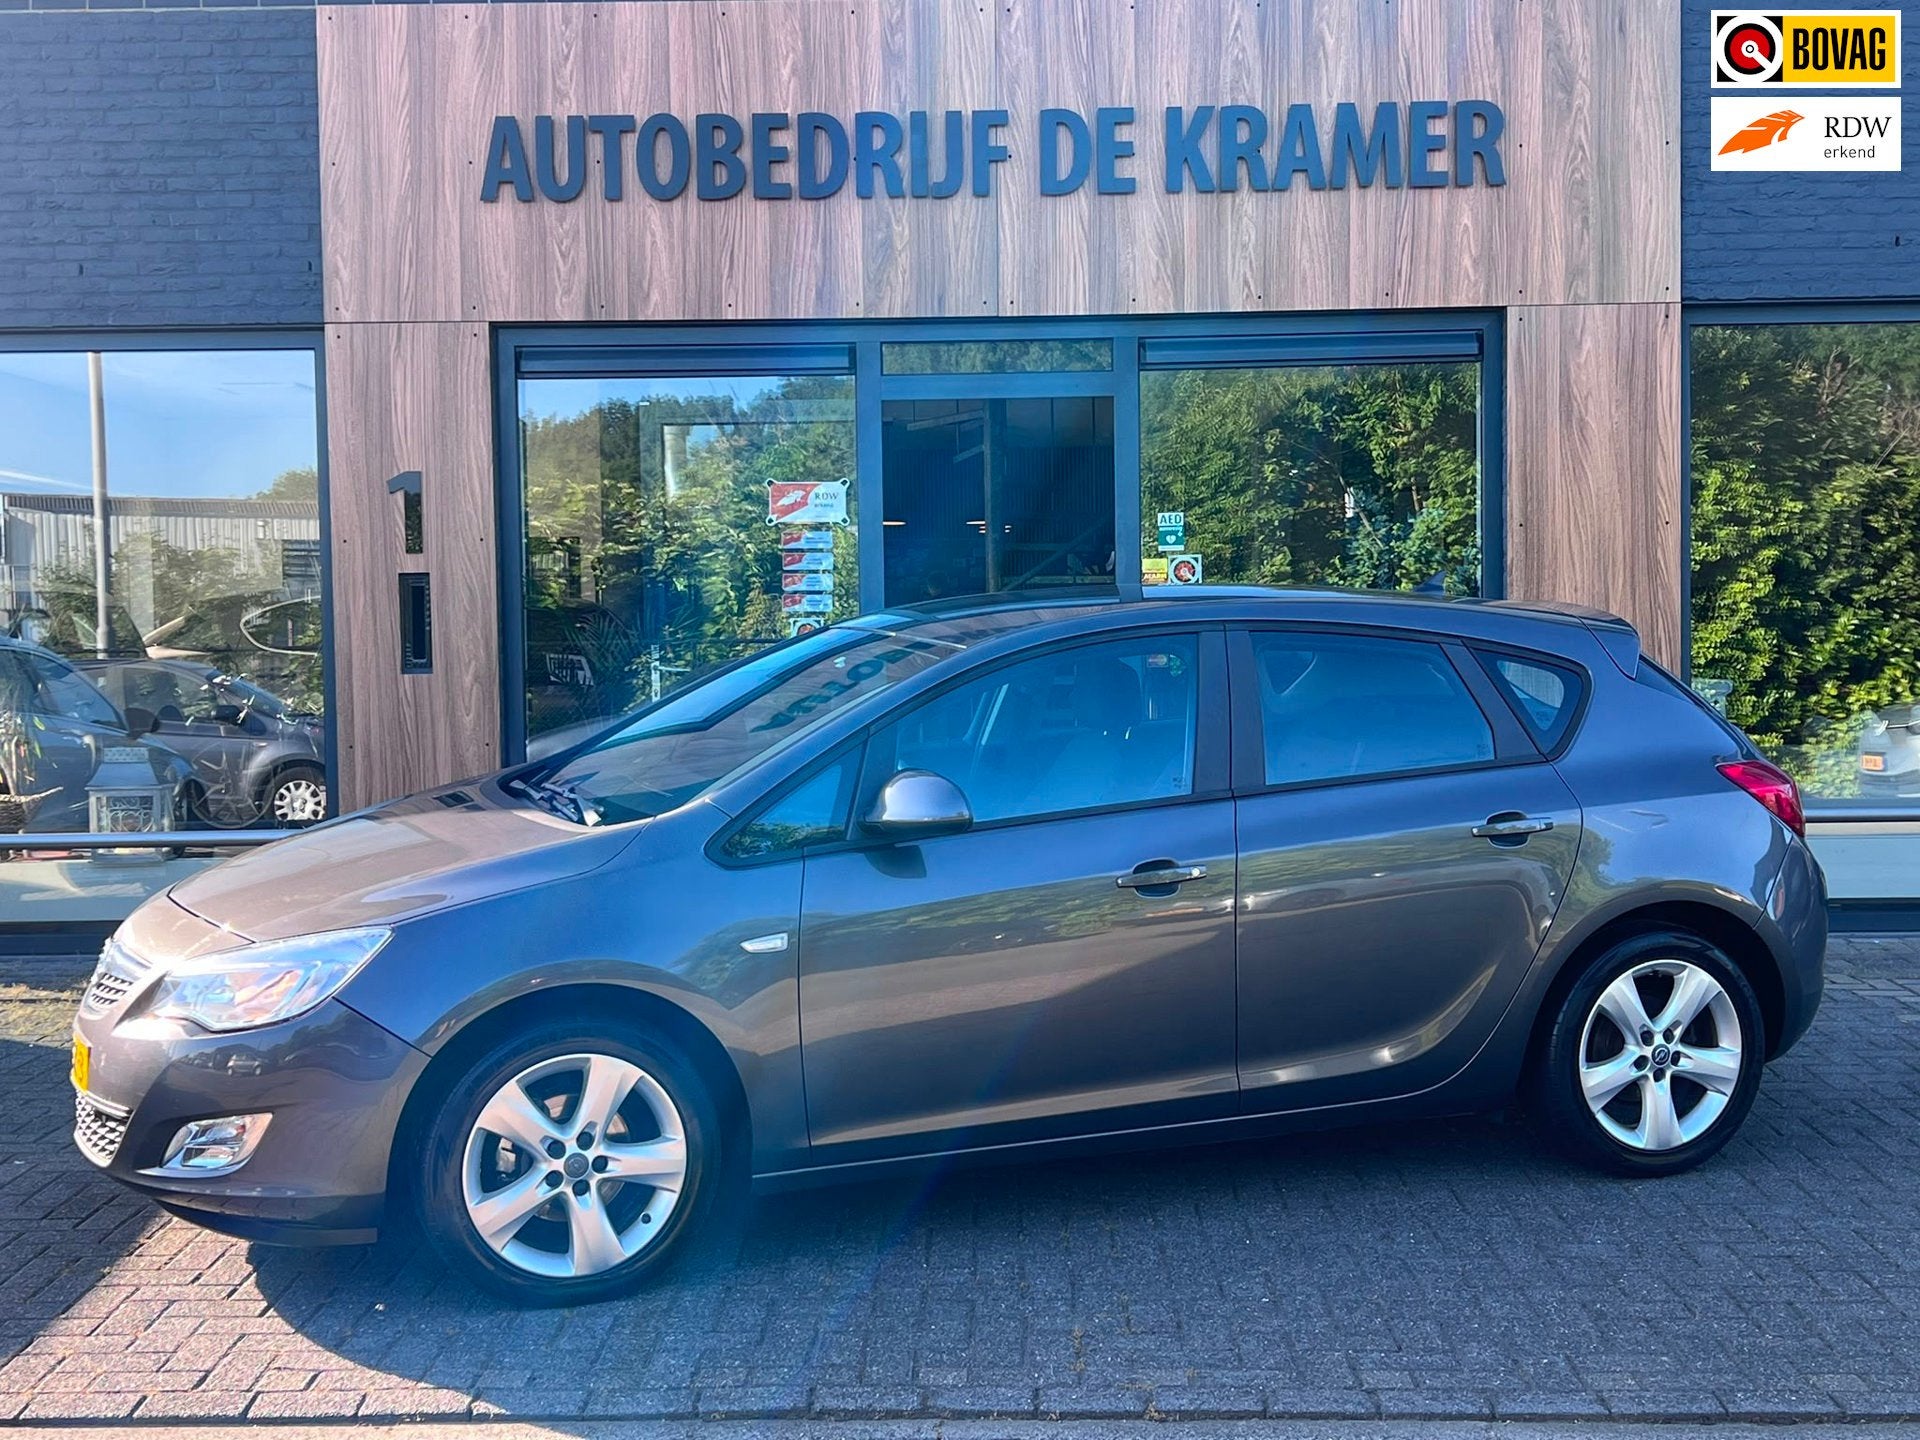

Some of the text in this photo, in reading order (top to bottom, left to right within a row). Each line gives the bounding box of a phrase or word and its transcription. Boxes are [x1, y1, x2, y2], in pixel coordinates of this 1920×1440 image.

[480, 100, 1507, 202] AUTOBEDRIJF DE KRAMER
[386, 470, 424, 554] 1
[814, 492, 840, 500] RDW
[1159, 513, 1182, 525] AED
